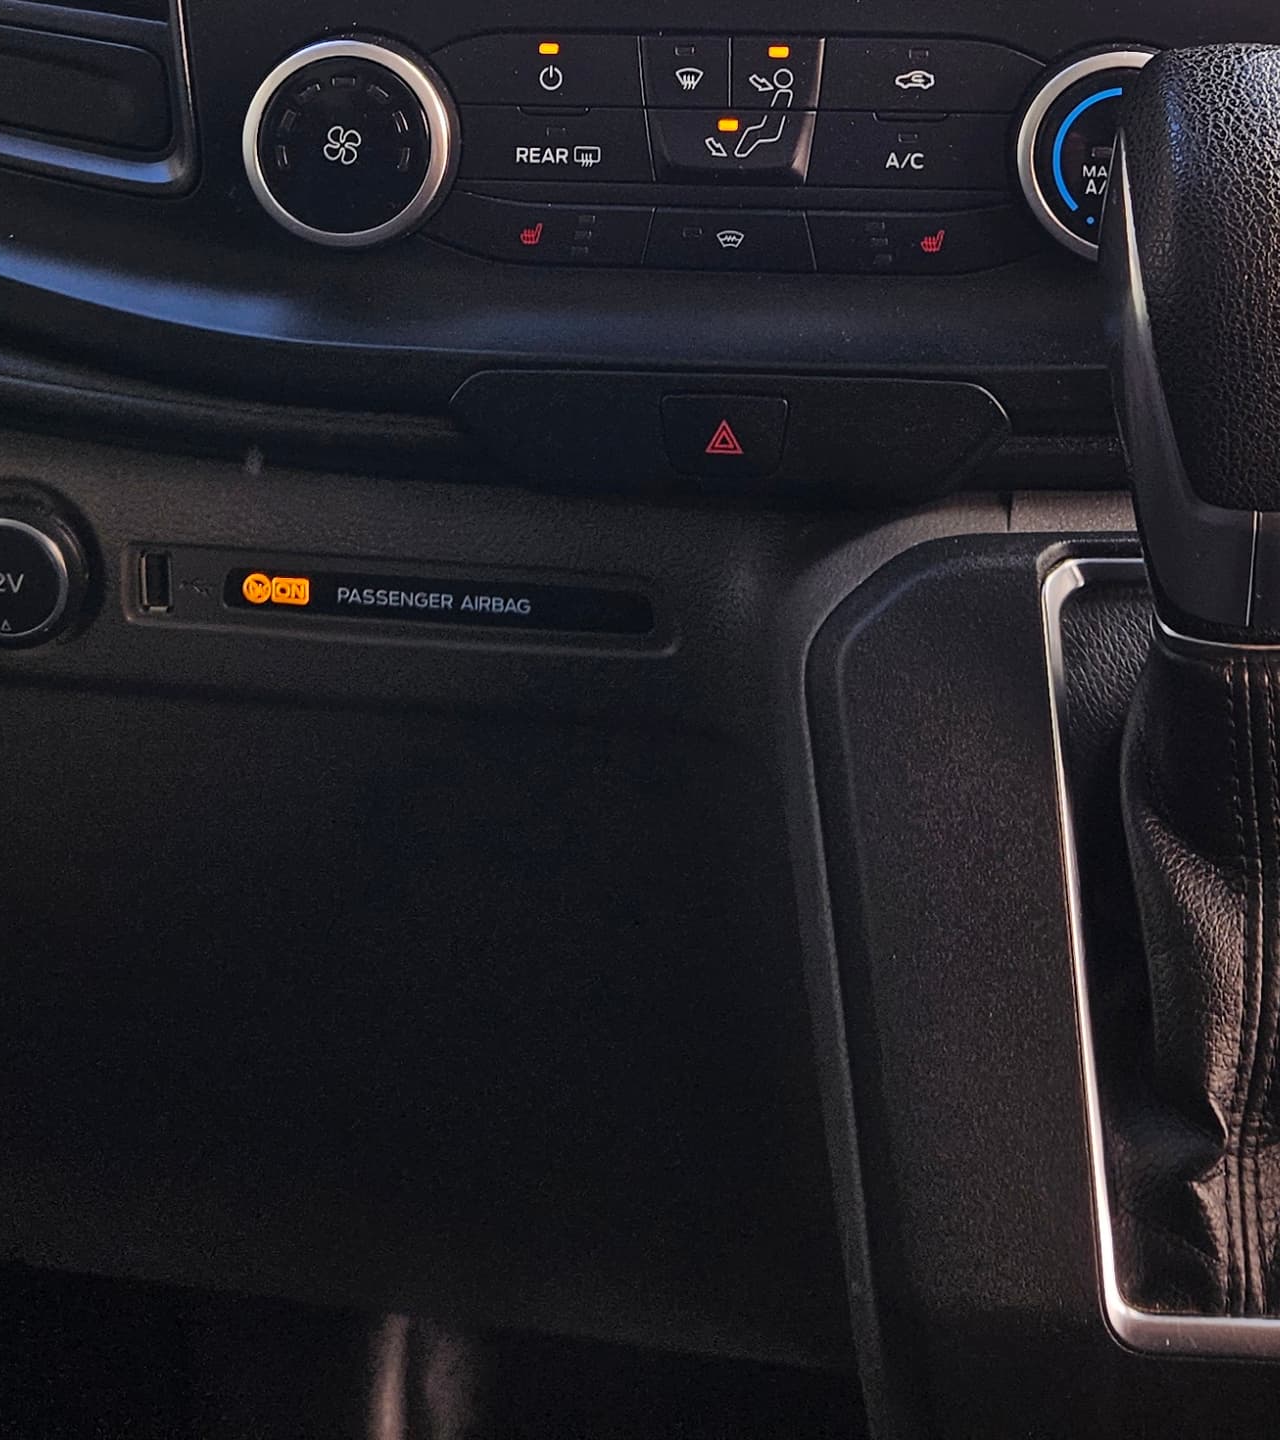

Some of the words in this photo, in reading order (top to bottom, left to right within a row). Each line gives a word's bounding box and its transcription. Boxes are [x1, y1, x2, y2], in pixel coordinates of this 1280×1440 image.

[516, 147, 568, 164] REAR
[886, 152, 924, 169] A/C
[1082, 165, 1108, 177] MA
[1085, 179, 1107, 194] A/
[337, 587, 453, 609] PASSENGER
[460, 594, 531, 614] AIRBAG
